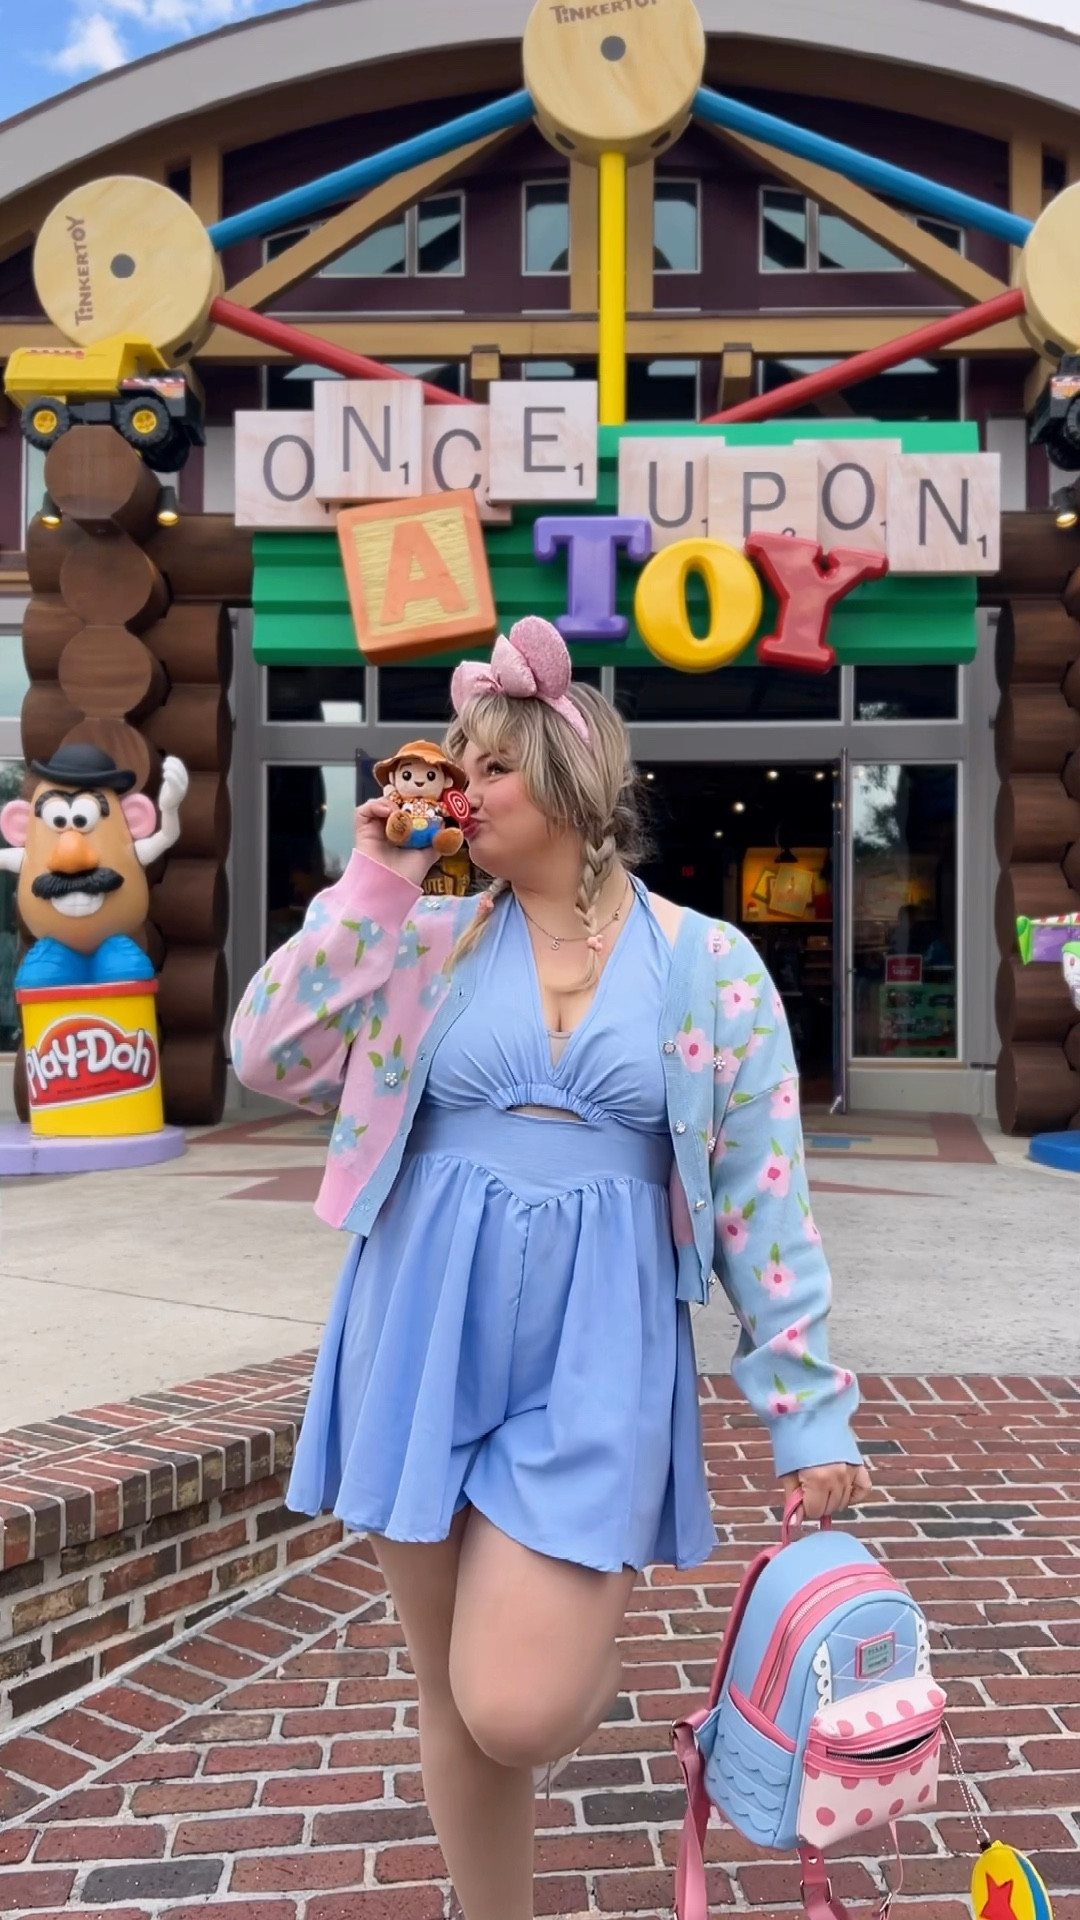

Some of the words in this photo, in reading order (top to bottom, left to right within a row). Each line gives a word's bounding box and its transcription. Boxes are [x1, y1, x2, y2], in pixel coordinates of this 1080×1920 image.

[262, 404, 566, 502] ONCE
[648, 460, 969, 546] UPON
[379, 519, 469, 625] A
[533, 515, 890, 674] TOY
